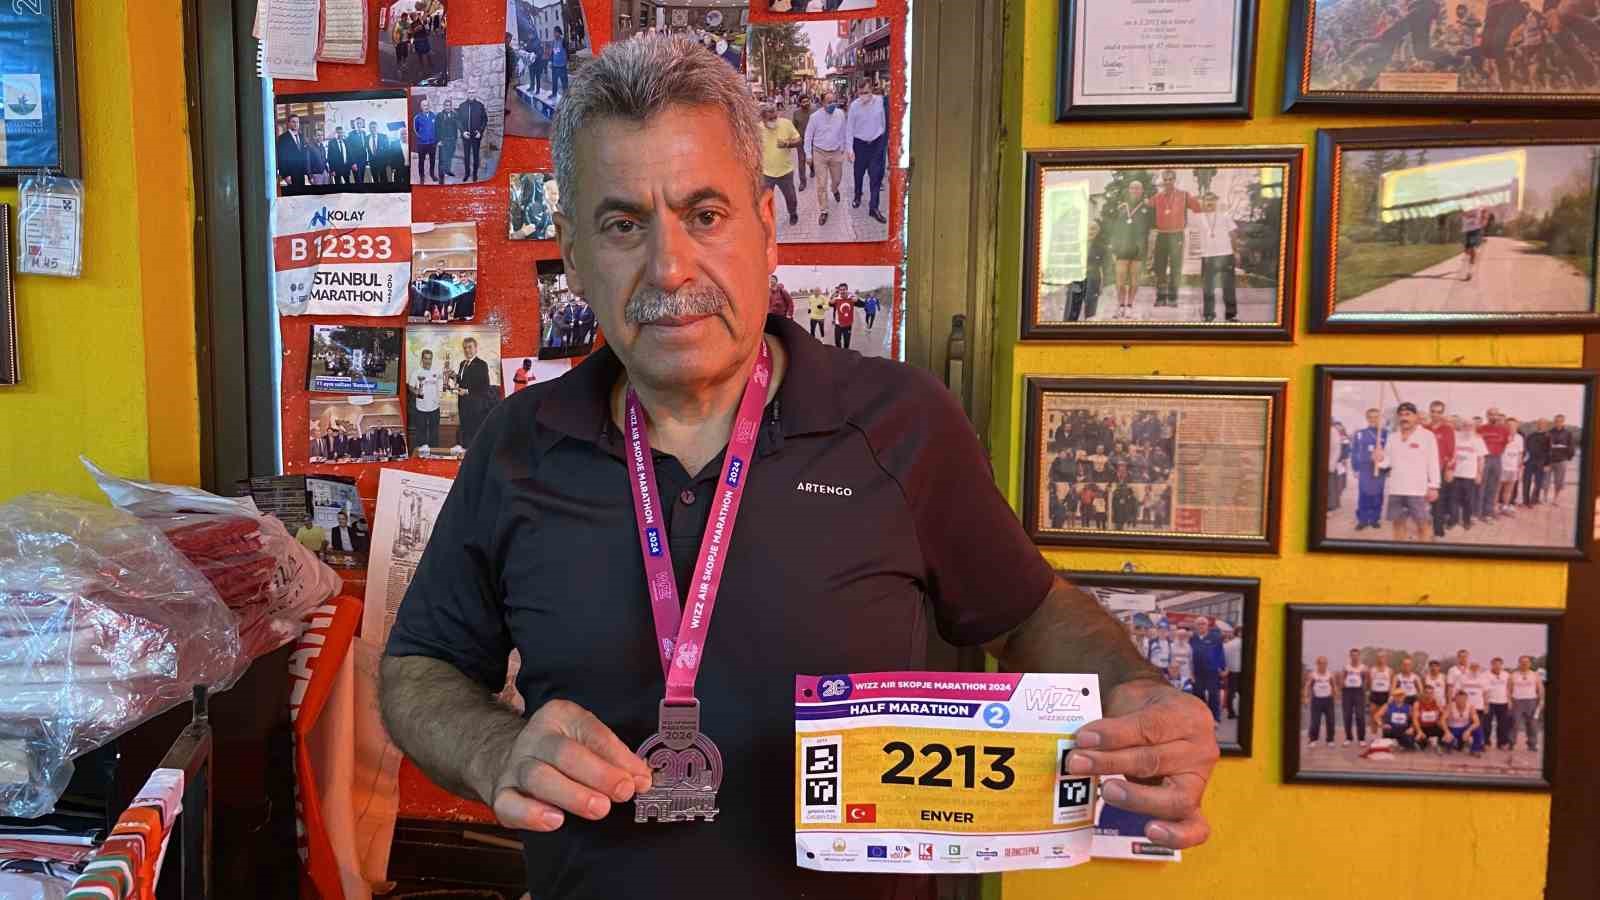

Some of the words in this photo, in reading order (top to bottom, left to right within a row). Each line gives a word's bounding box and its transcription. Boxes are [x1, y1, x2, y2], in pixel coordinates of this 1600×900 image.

[327, 211, 364, 221] KOLAY
[291, 238, 307, 260] B
[314, 234, 392, 260] 12333
[313, 271, 382, 286] STANBUL
[309, 289, 383, 303] MARATHON
[632, 440, 645, 472] SKOPJE
[729, 461, 741, 483] 2024
[637, 472, 654, 524] MARATHON
[797, 482, 852, 496] ARTENGO
[714, 490, 733, 544] MARATHON
[648, 531, 659, 553] 2024
[702, 545, 719, 583] SKOPJE
[698, 583, 709, 601] AIR
[690, 603, 704, 629] WIZZ
[855, 682, 878, 690] WIZZ
[898, 681, 932, 689] SKOPJE
[934, 682, 987, 691] MARATHON
[988, 683, 1012, 691] 2024
[850, 703, 885, 715] HALF
[889, 703, 969, 716] MARATHON
[989, 707, 1004, 725] 2
[881, 741, 1016, 790] 2213
[920, 809, 974, 823] ENVER
